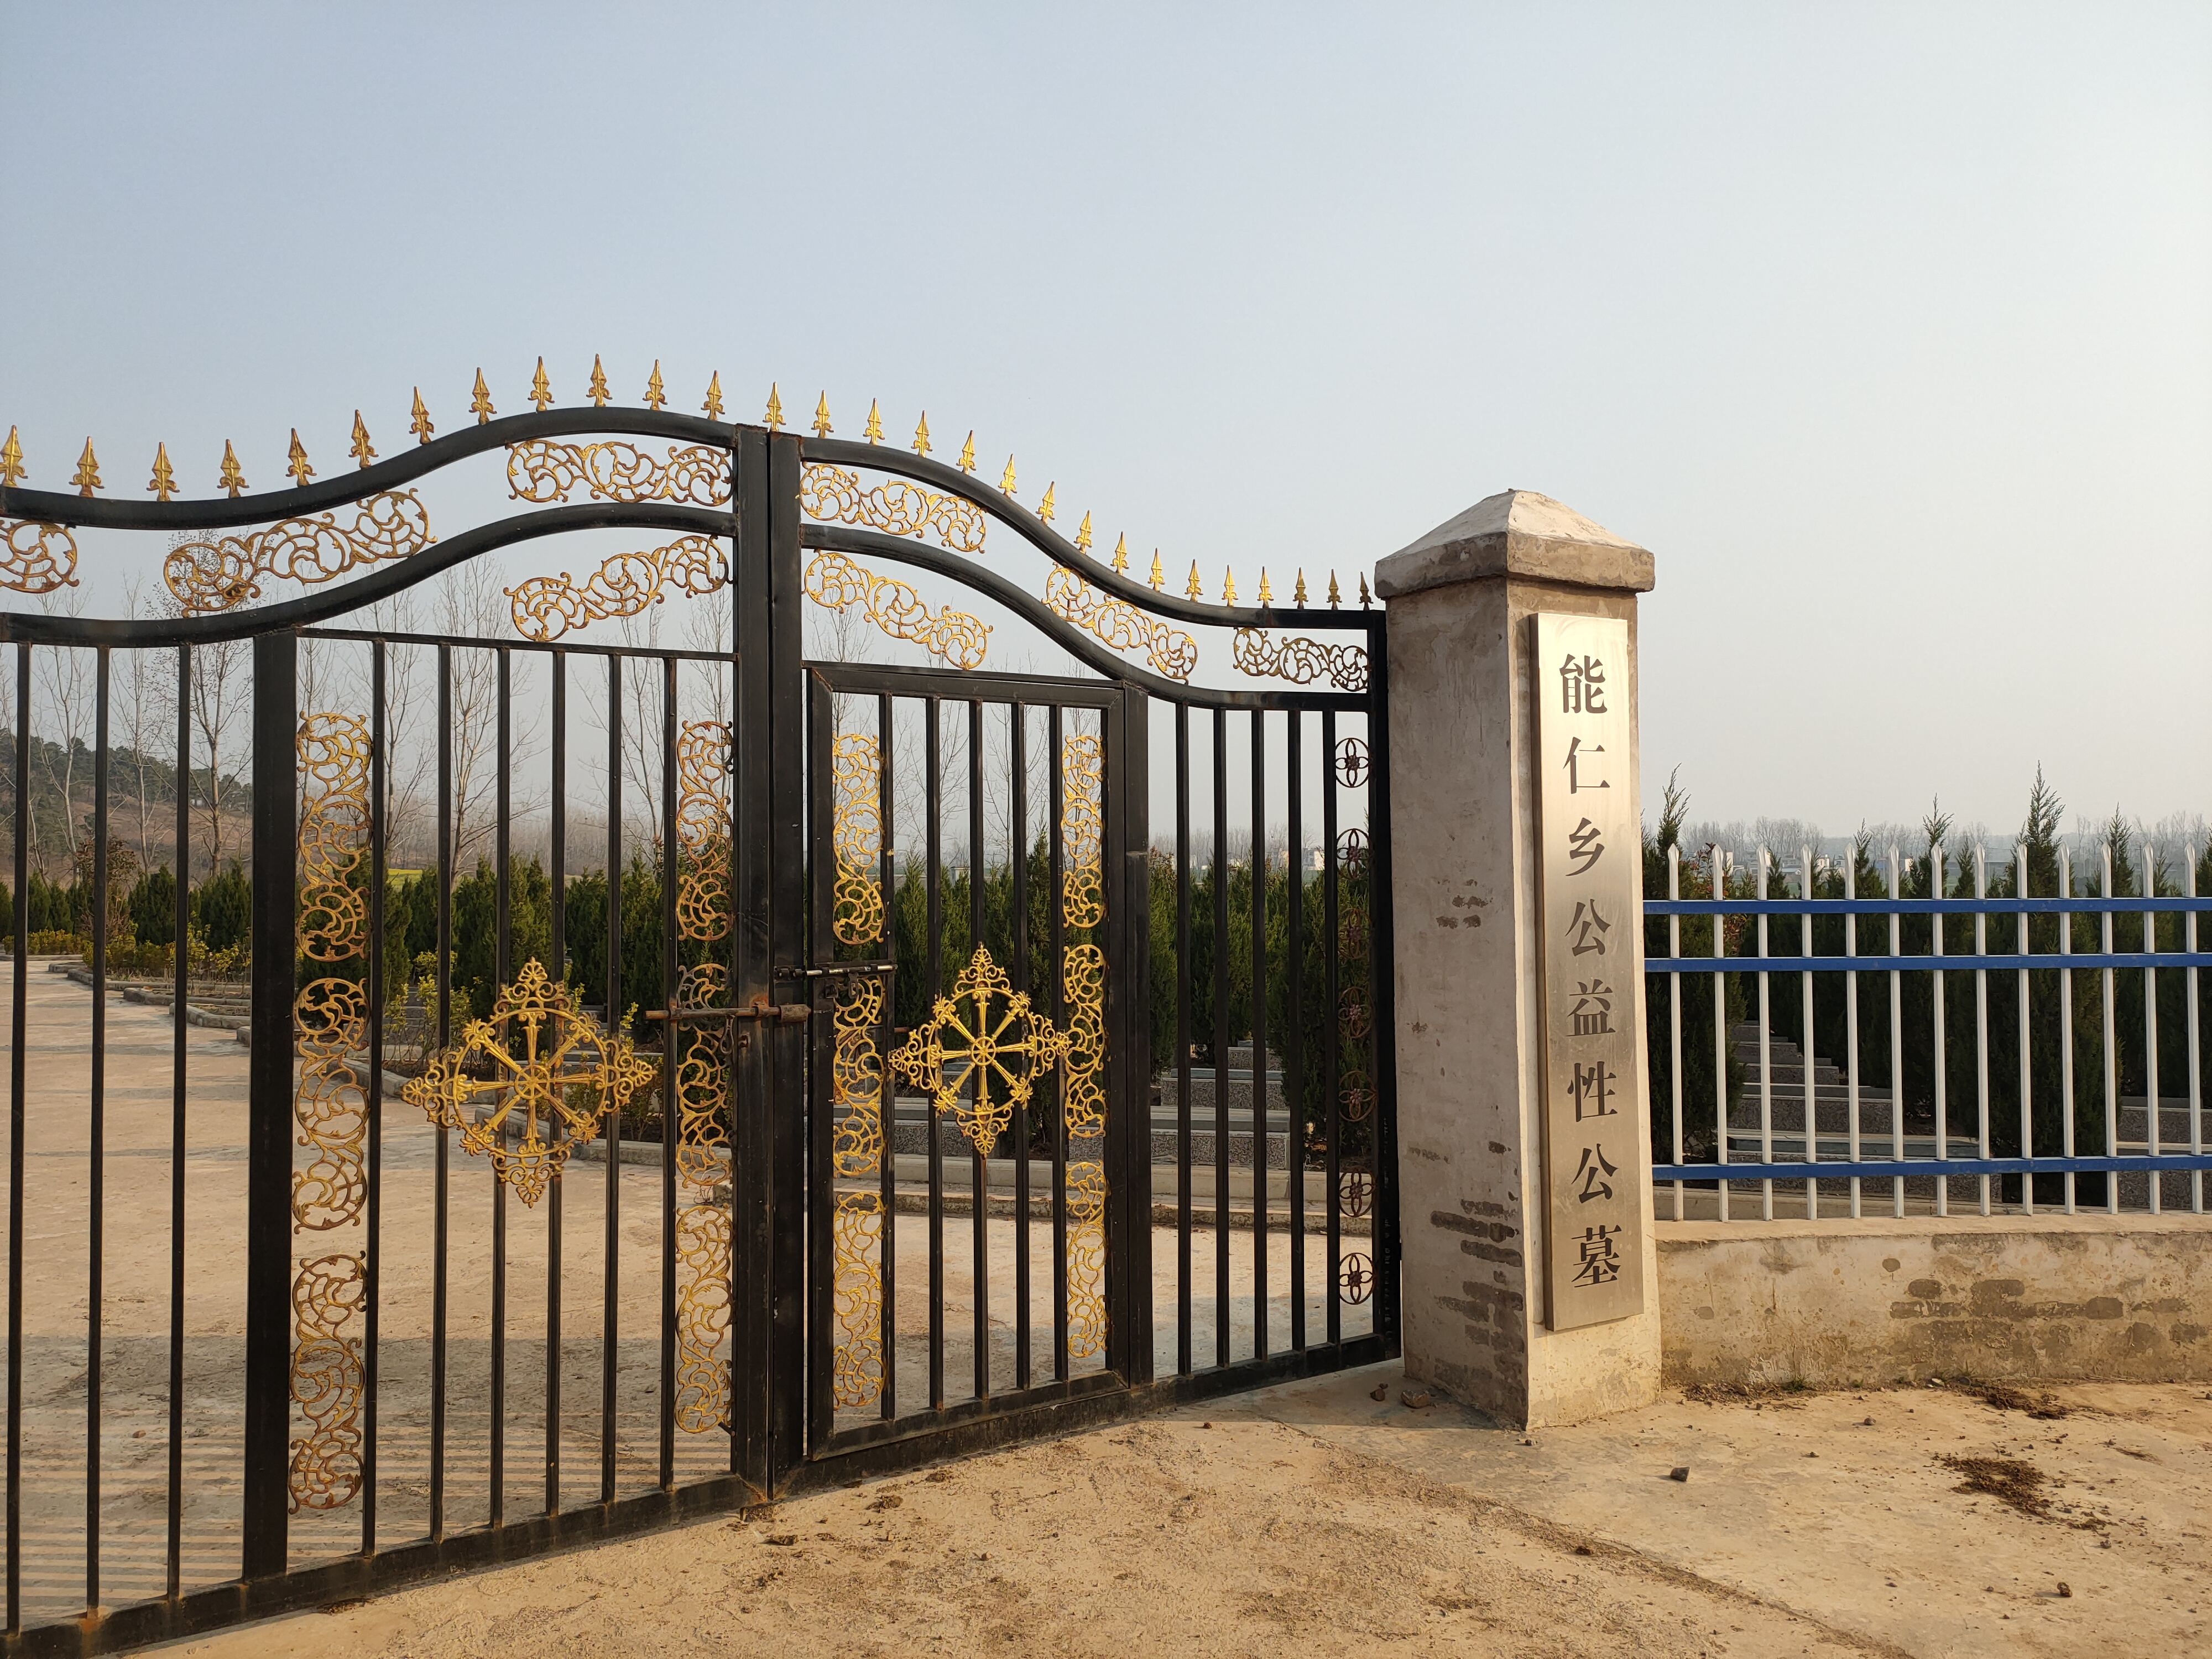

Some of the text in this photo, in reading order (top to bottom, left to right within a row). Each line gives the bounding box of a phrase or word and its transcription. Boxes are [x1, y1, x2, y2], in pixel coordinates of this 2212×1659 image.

[1559, 653, 1622, 1288] 能仁乡公益性公墓
